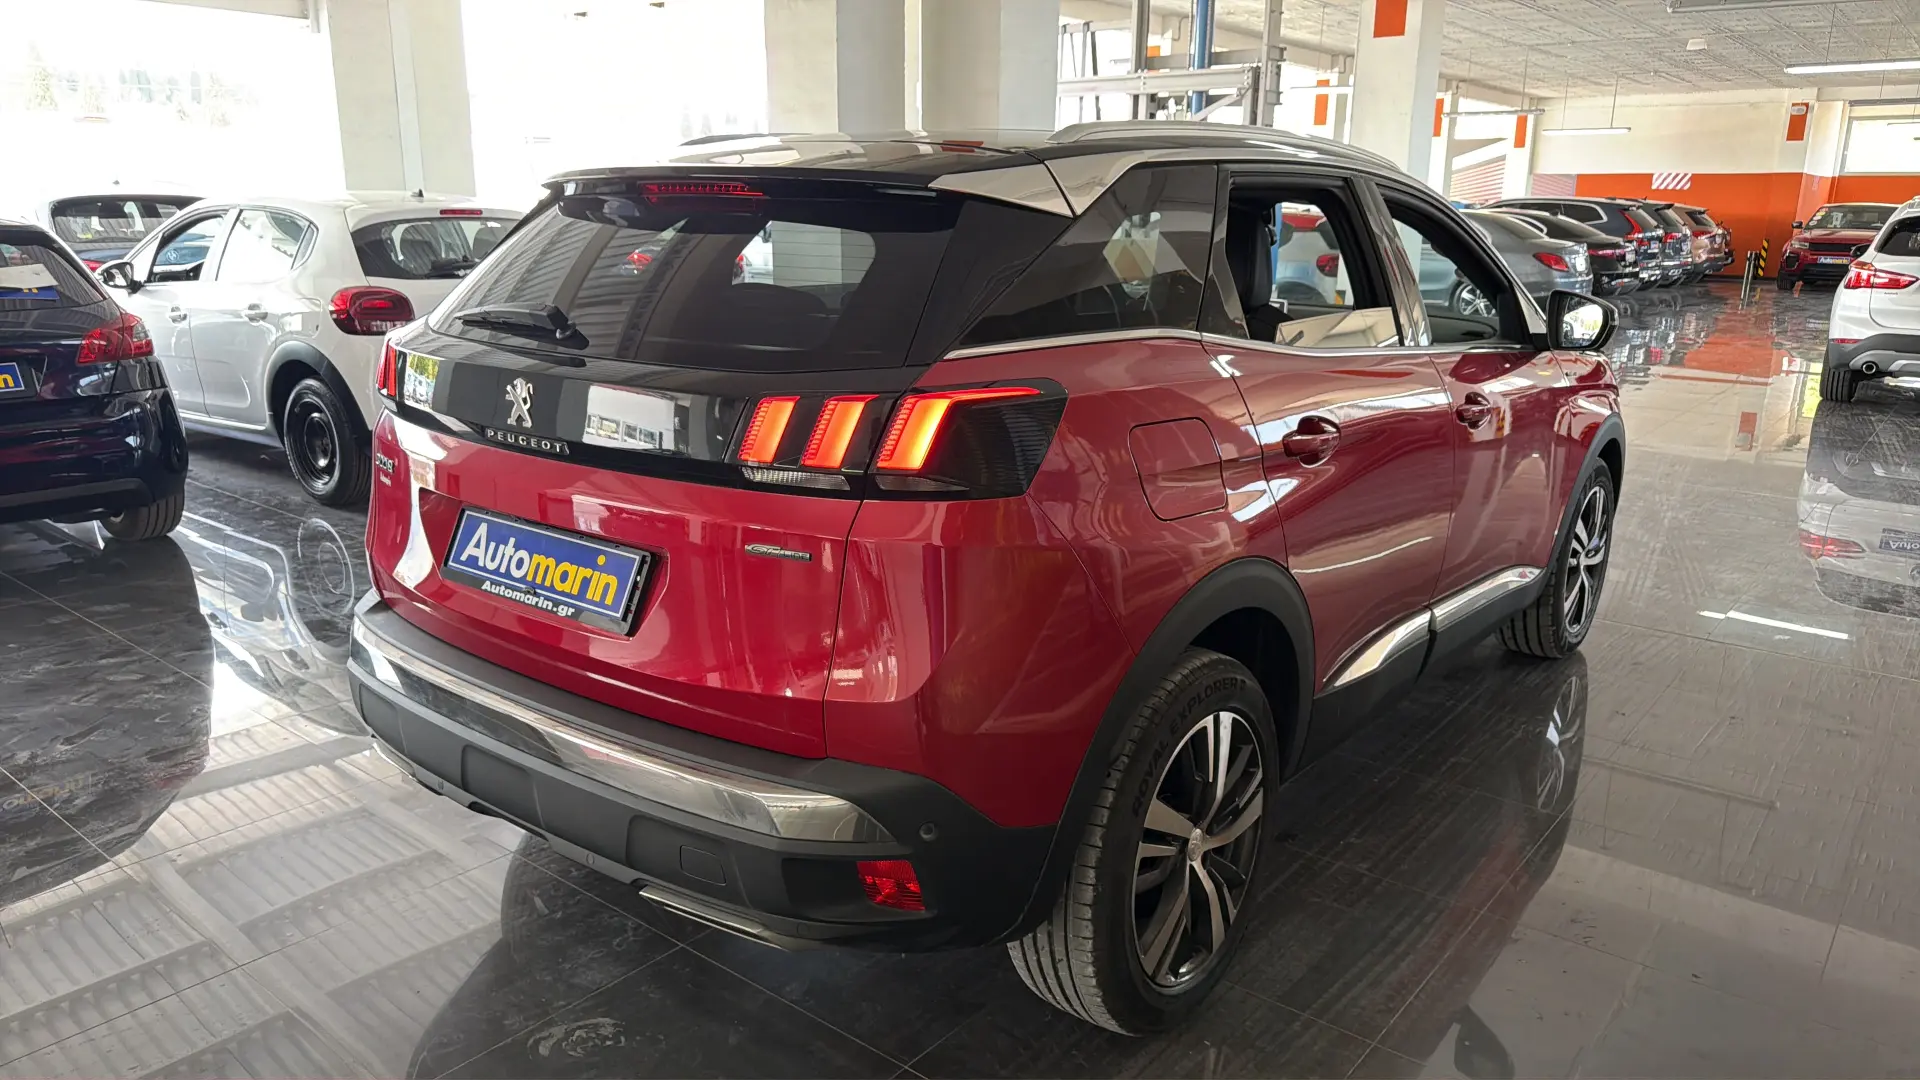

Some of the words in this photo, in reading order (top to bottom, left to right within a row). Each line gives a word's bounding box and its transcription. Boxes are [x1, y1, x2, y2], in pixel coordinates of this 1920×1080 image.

[487, 429, 562, 453] PEUGEOT
[460, 522, 618, 606] Automarin
[481, 580, 575, 617] Automarin.gr
[1169, 677, 1239, 736] EXPLORER
